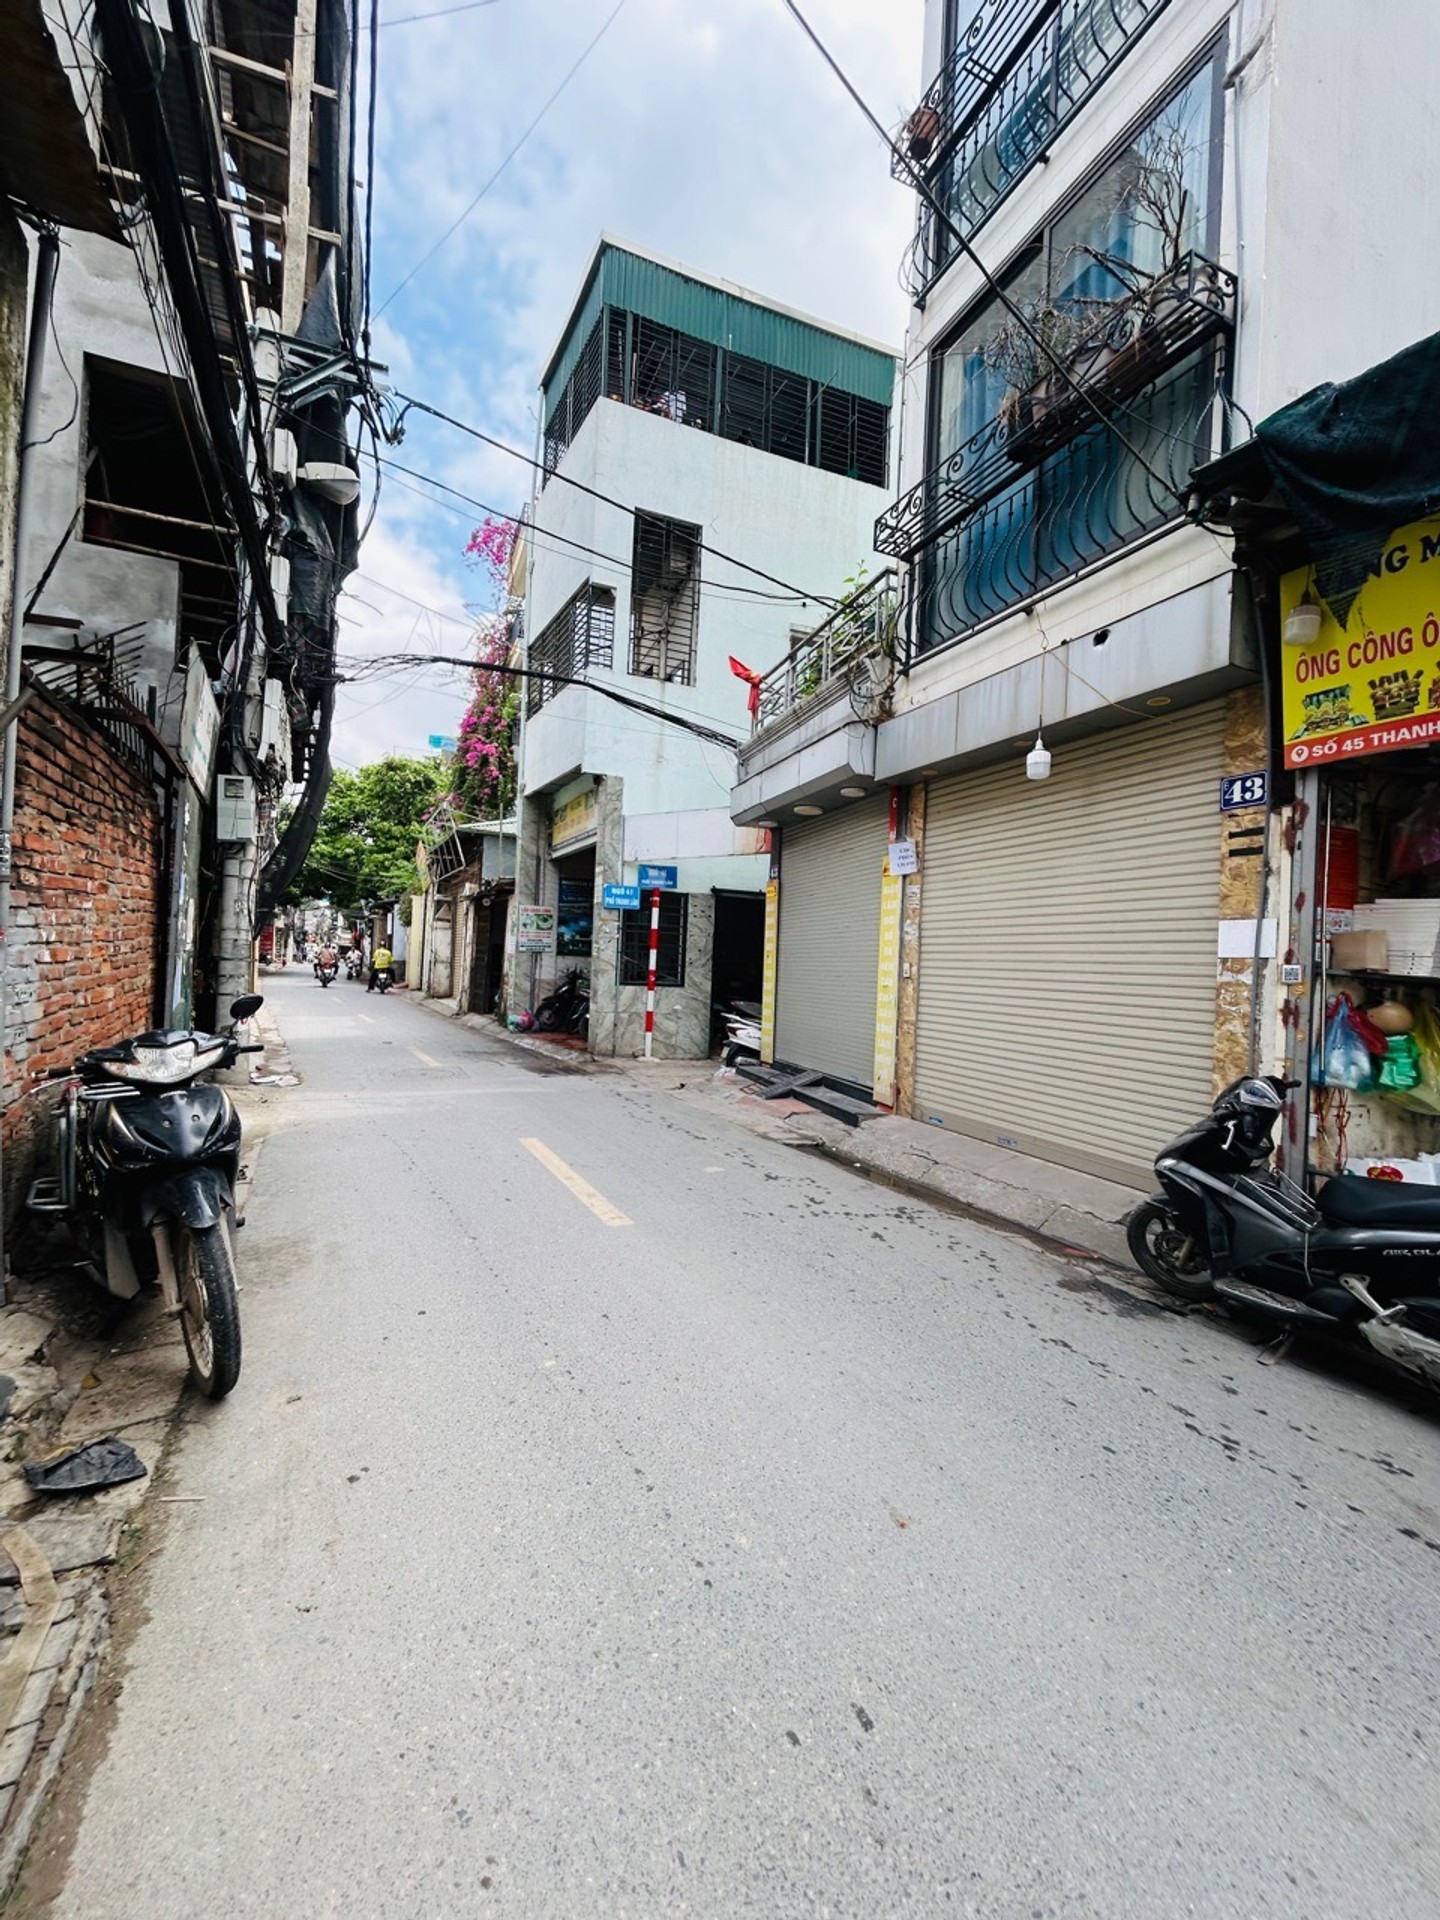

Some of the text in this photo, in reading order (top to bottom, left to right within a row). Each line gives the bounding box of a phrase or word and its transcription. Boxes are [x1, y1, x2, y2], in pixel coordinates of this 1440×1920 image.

[1295, 652, 1341, 684] ÔNG
[1347, 630, 1413, 669] CÔNG
[1312, 720, 1440, 757] SỐ 45 THANH
[1224, 777, 1263, 803] 43
